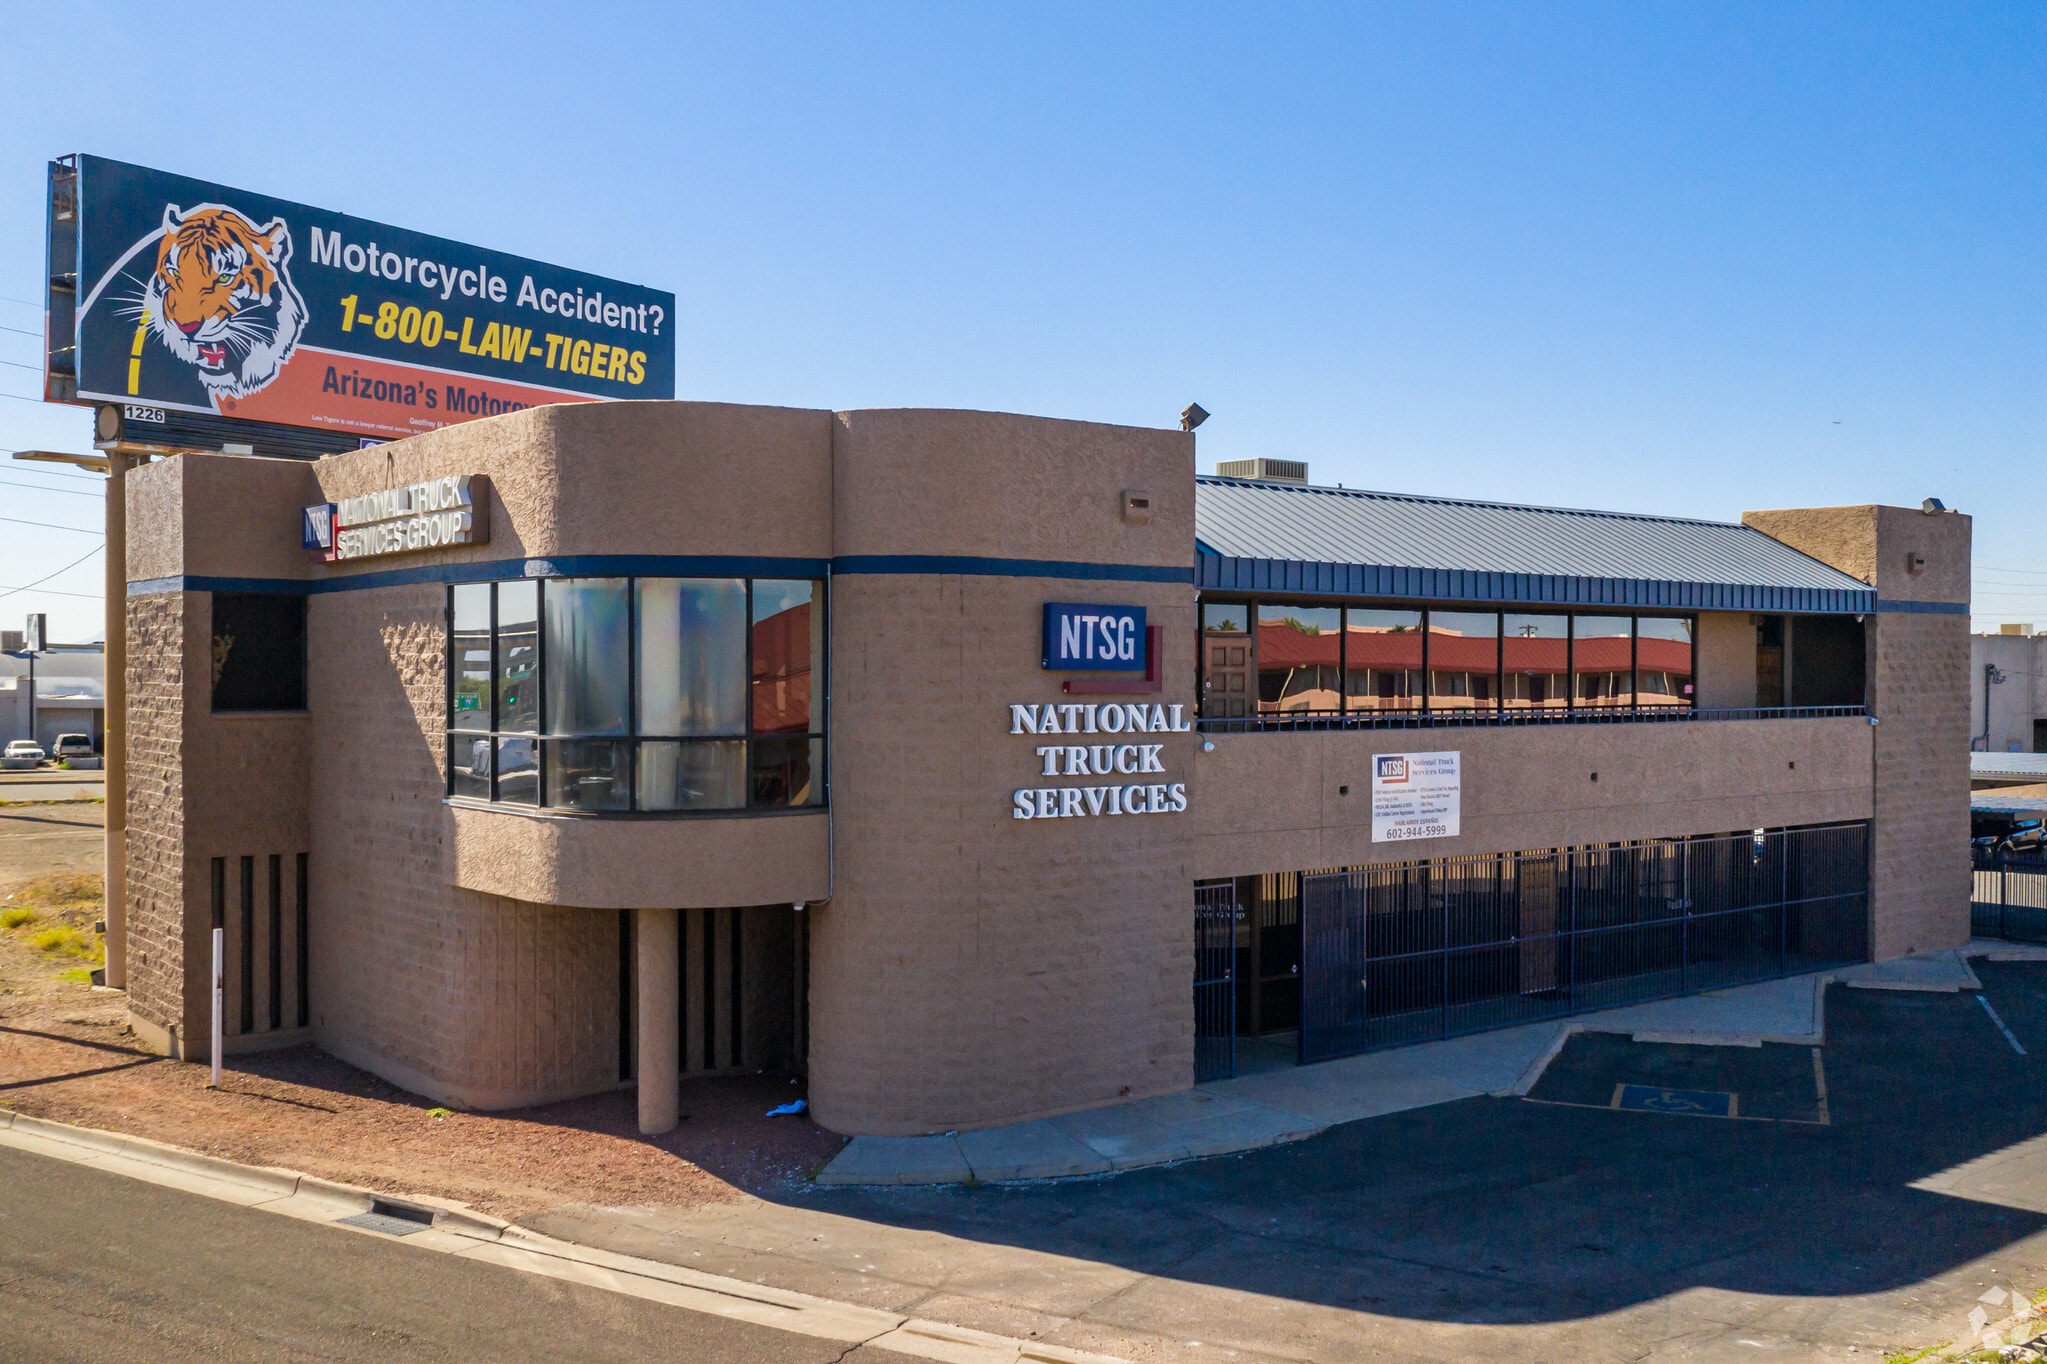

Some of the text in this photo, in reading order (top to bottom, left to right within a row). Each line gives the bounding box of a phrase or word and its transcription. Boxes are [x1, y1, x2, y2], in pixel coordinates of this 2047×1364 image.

[311, 226, 665, 336] Motorcycle Accident?
[340, 295, 648, 386] 1-800-LAW-TIGERS
[321, 366, 438, 409] Arizona's
[126, 407, 163, 421] 1226
[324, 415, 339, 424] Tigers
[359, 421, 376, 429] lawyer
[376, 423, 394, 431] referral
[409, 417, 436, 429] Geoffrey
[337, 475, 467, 527] NATIONAL TRUCK
[305, 511, 327, 542] NTSG
[337, 511, 465, 560] SERVICES GROUP
[1061, 615, 1134, 660] NTSG
[1009, 704, 1191, 734] NATIONAL
[1036, 744, 1166, 776] TRUCK
[1381, 760, 1403, 776] NTSG
[1412, 757, 1454, 767] National Truck
[1412, 768, 1456, 776] Services Group
[1013, 783, 1188, 819] SERVICES
[1386, 825, 1447, 839] 602-944-5999
